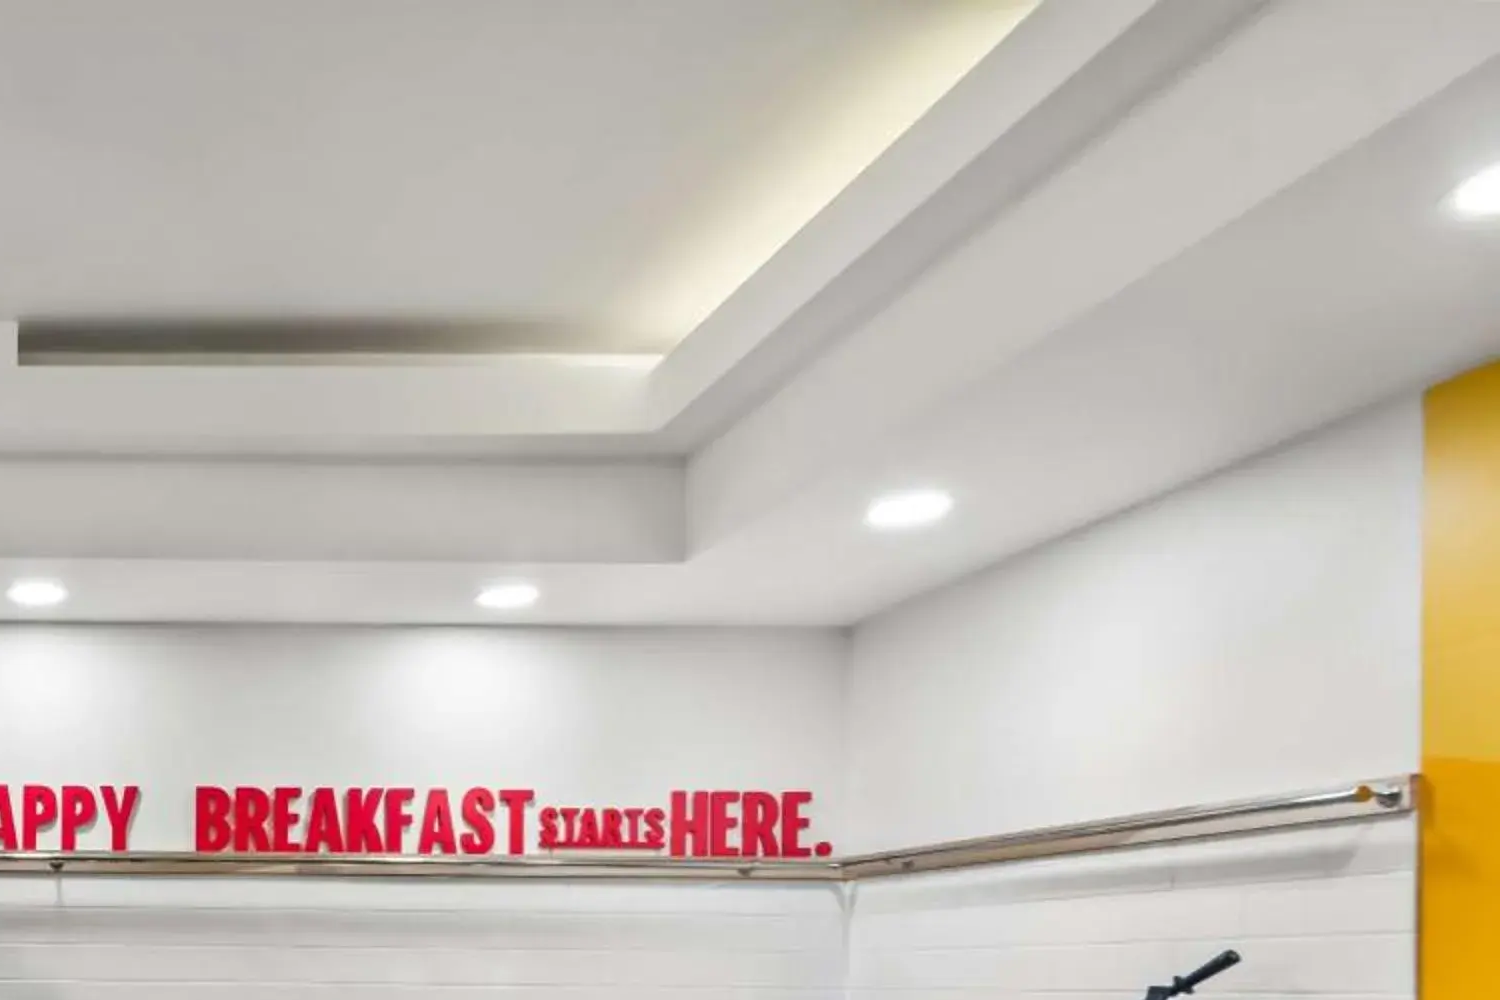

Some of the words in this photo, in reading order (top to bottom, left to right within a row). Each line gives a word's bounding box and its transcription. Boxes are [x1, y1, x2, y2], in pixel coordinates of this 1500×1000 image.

[194, 785, 535, 856] BREAKFAST
[539, 806, 667, 850] STARTS
[668, 790, 833, 859] HERE.
